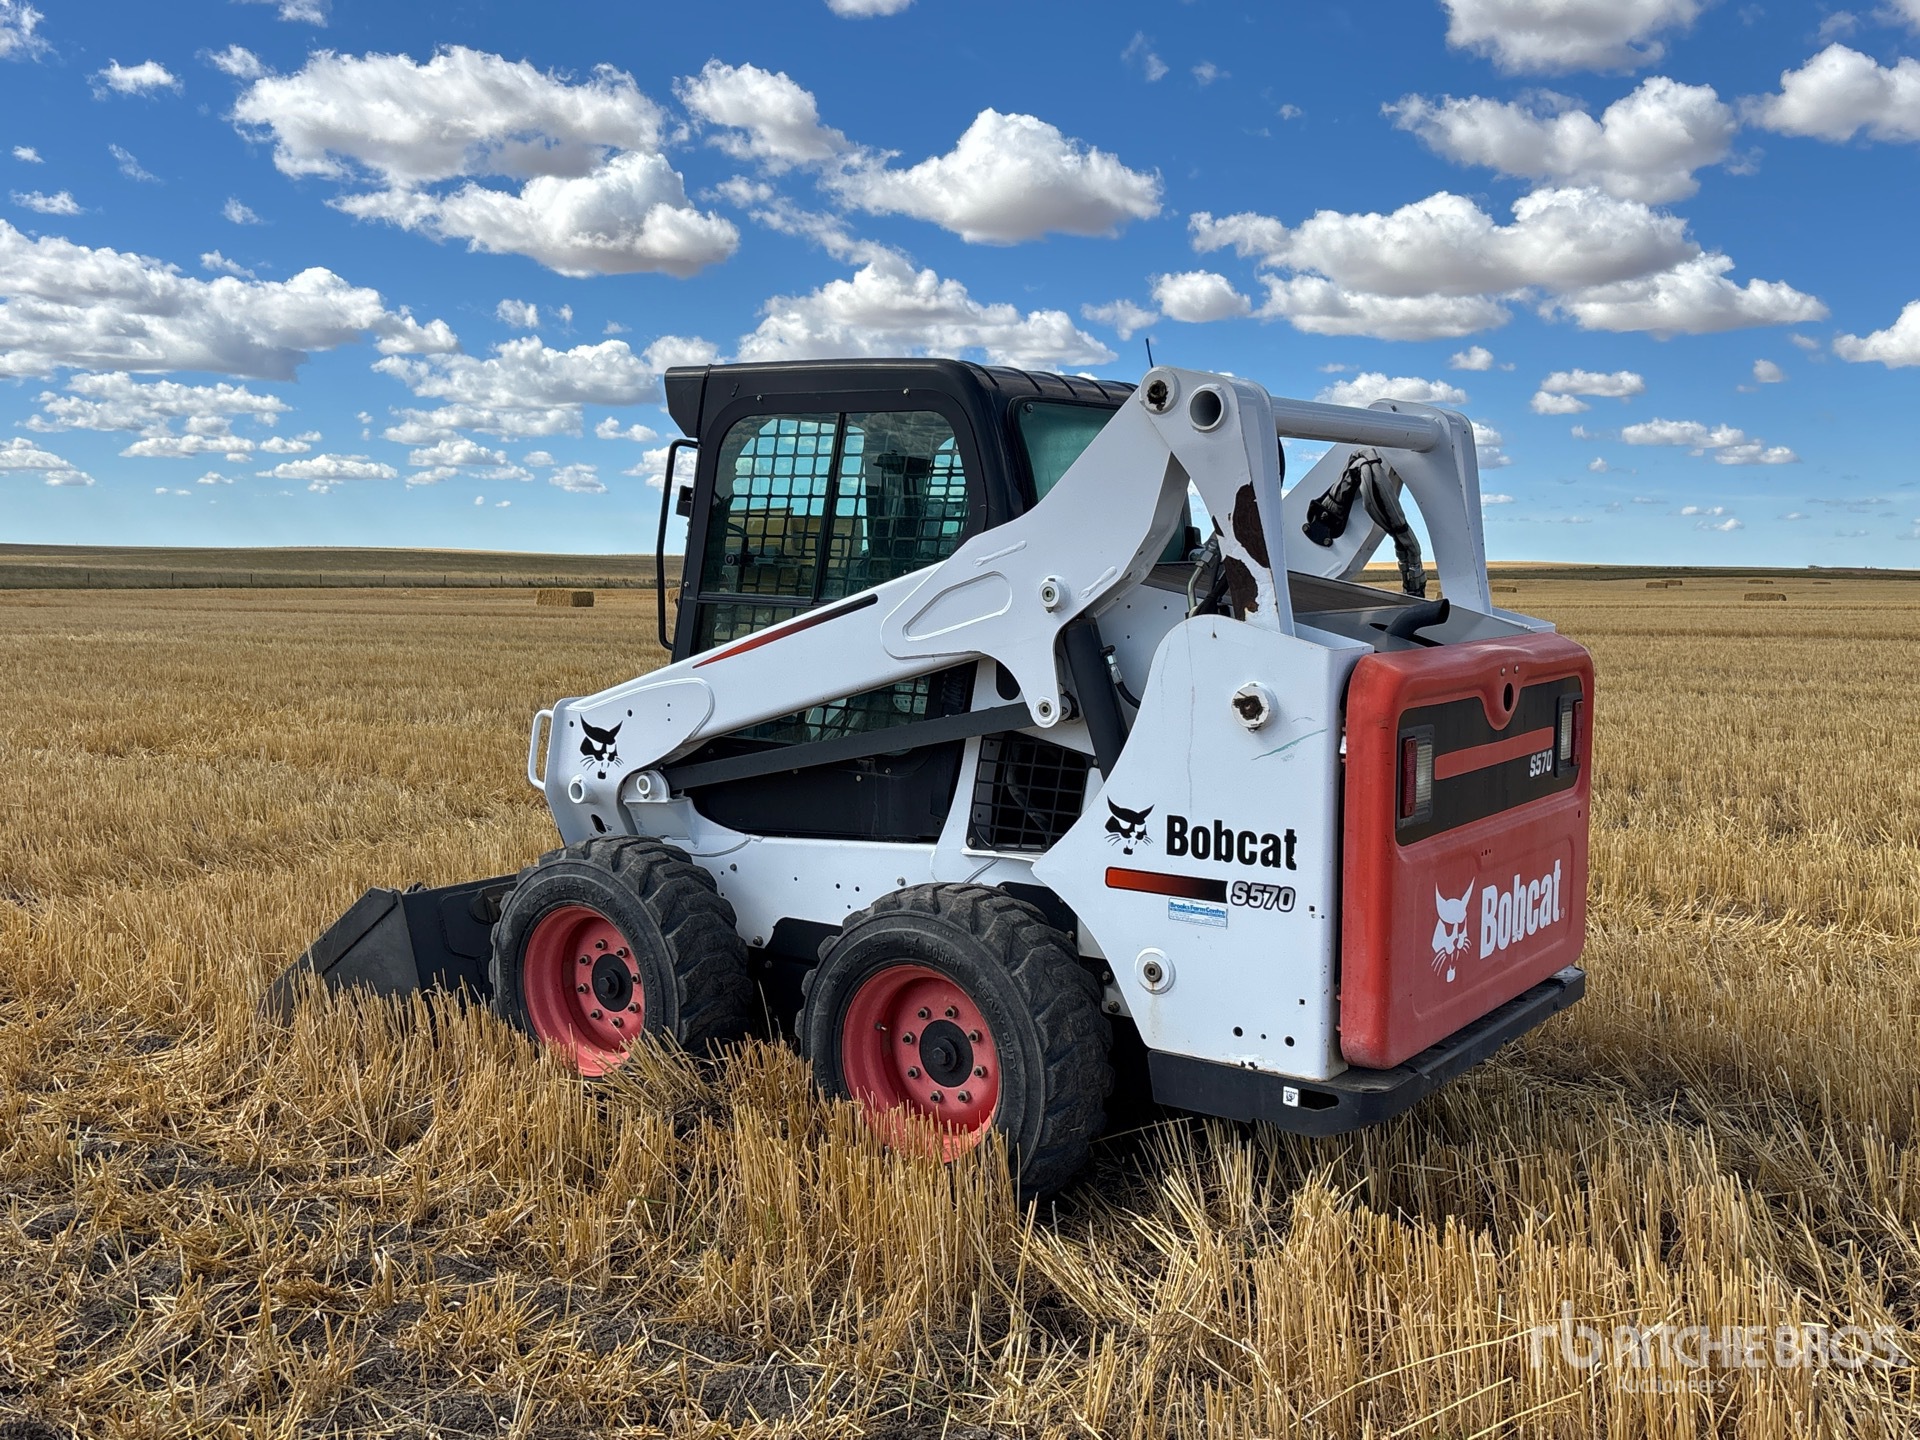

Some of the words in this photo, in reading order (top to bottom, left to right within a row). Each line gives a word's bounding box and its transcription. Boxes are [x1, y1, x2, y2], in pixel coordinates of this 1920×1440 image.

[1529, 750, 1553, 778] S570
[1166, 815, 1297, 870] Bobcat
[1170, 902, 1190, 910] Brooks
[1230, 881, 1296, 912] S570
[1480, 859, 1562, 960] Bobcat
[925, 942, 962, 974] Bobcat
[1002, 1031, 1018, 1073] DUTY
